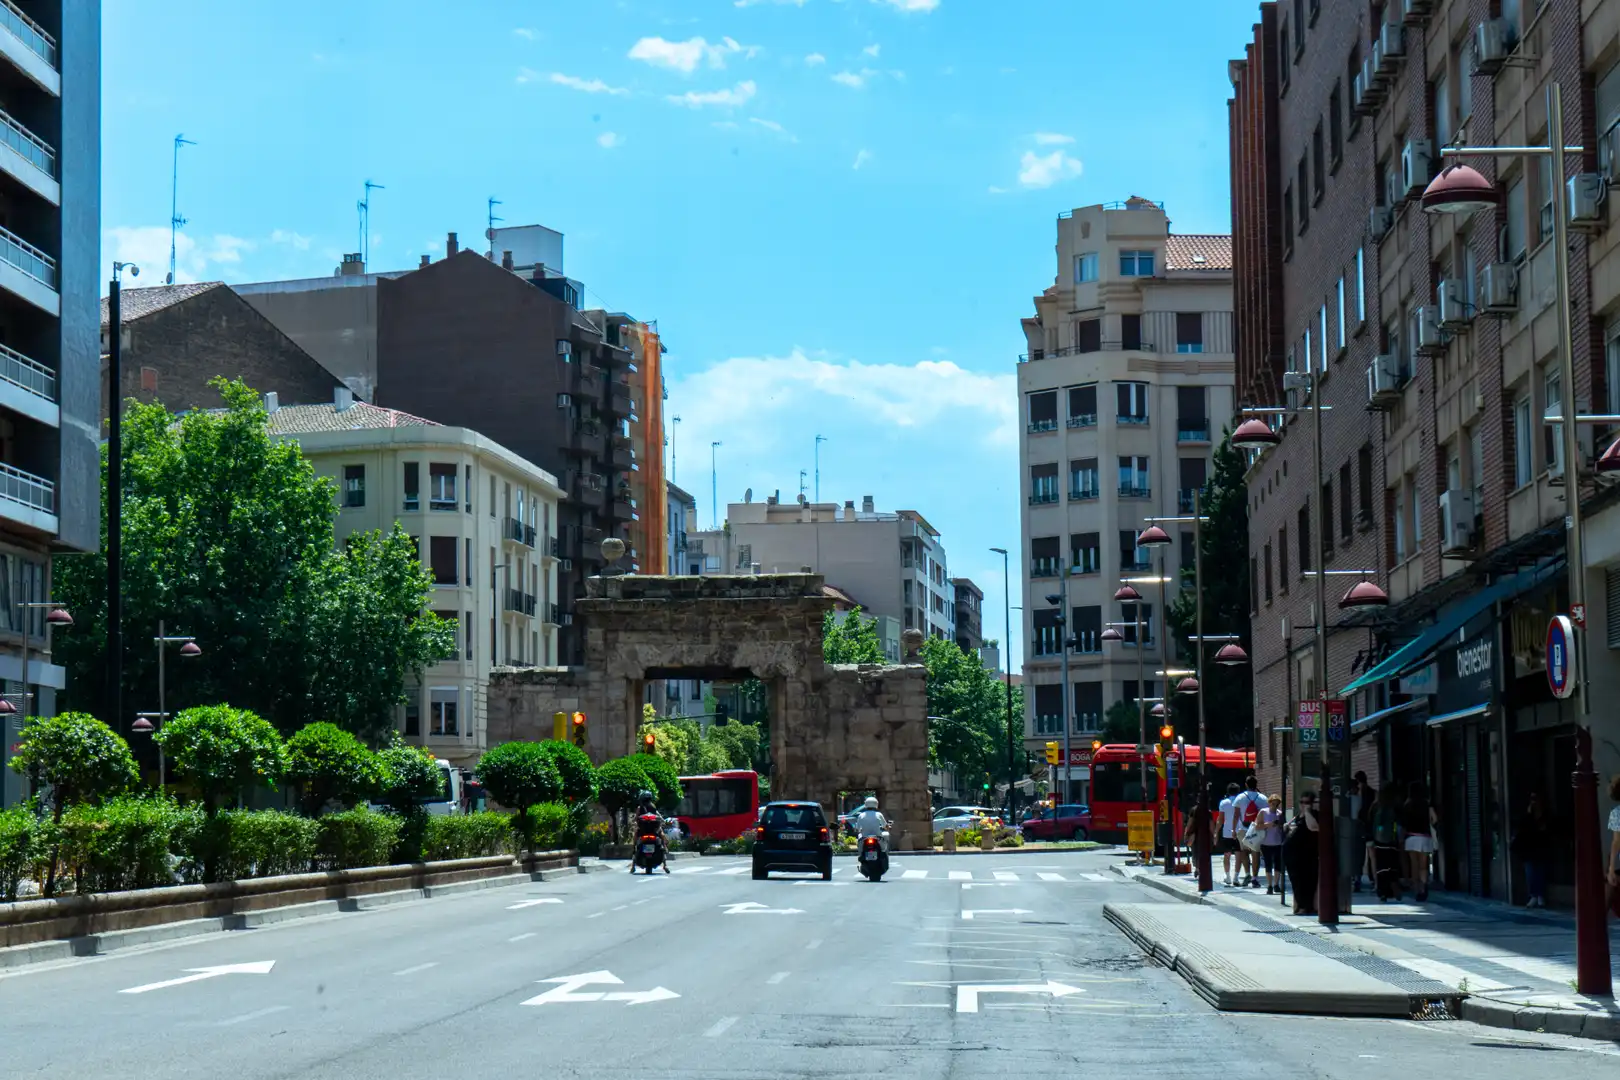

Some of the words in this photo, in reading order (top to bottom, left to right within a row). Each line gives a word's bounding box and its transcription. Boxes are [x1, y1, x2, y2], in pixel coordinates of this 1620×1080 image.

[1456, 637, 1493, 678] bienestar
[1298, 714, 1313, 728] 32
[1331, 714, 1345, 728] 34
[1303, 729, 1318, 741] 52
